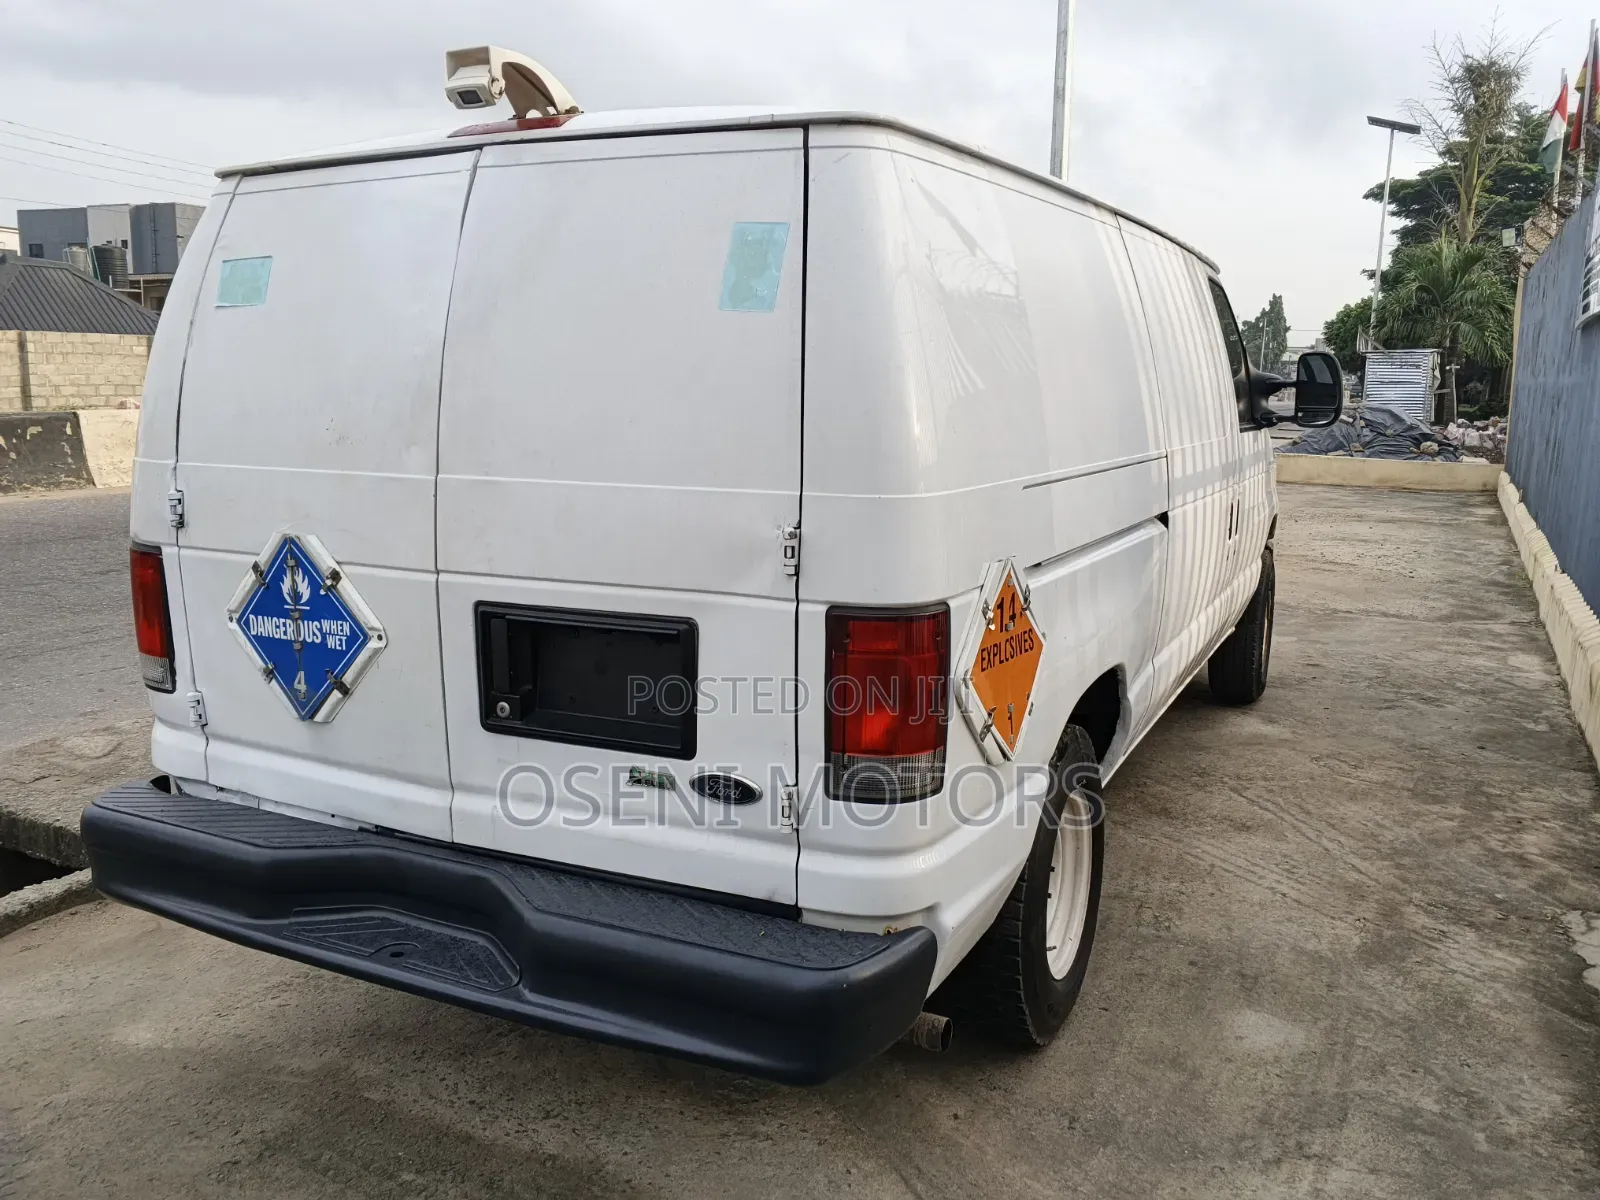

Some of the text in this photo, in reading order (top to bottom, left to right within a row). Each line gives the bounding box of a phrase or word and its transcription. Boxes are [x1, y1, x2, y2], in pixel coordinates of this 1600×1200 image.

[248, 614, 322, 644] DANGEROUS
[321, 618, 350, 636] WHEN
[327, 634, 347, 651] WET
[293, 670, 307, 693] 4
[706, 778, 742, 799] Ford
